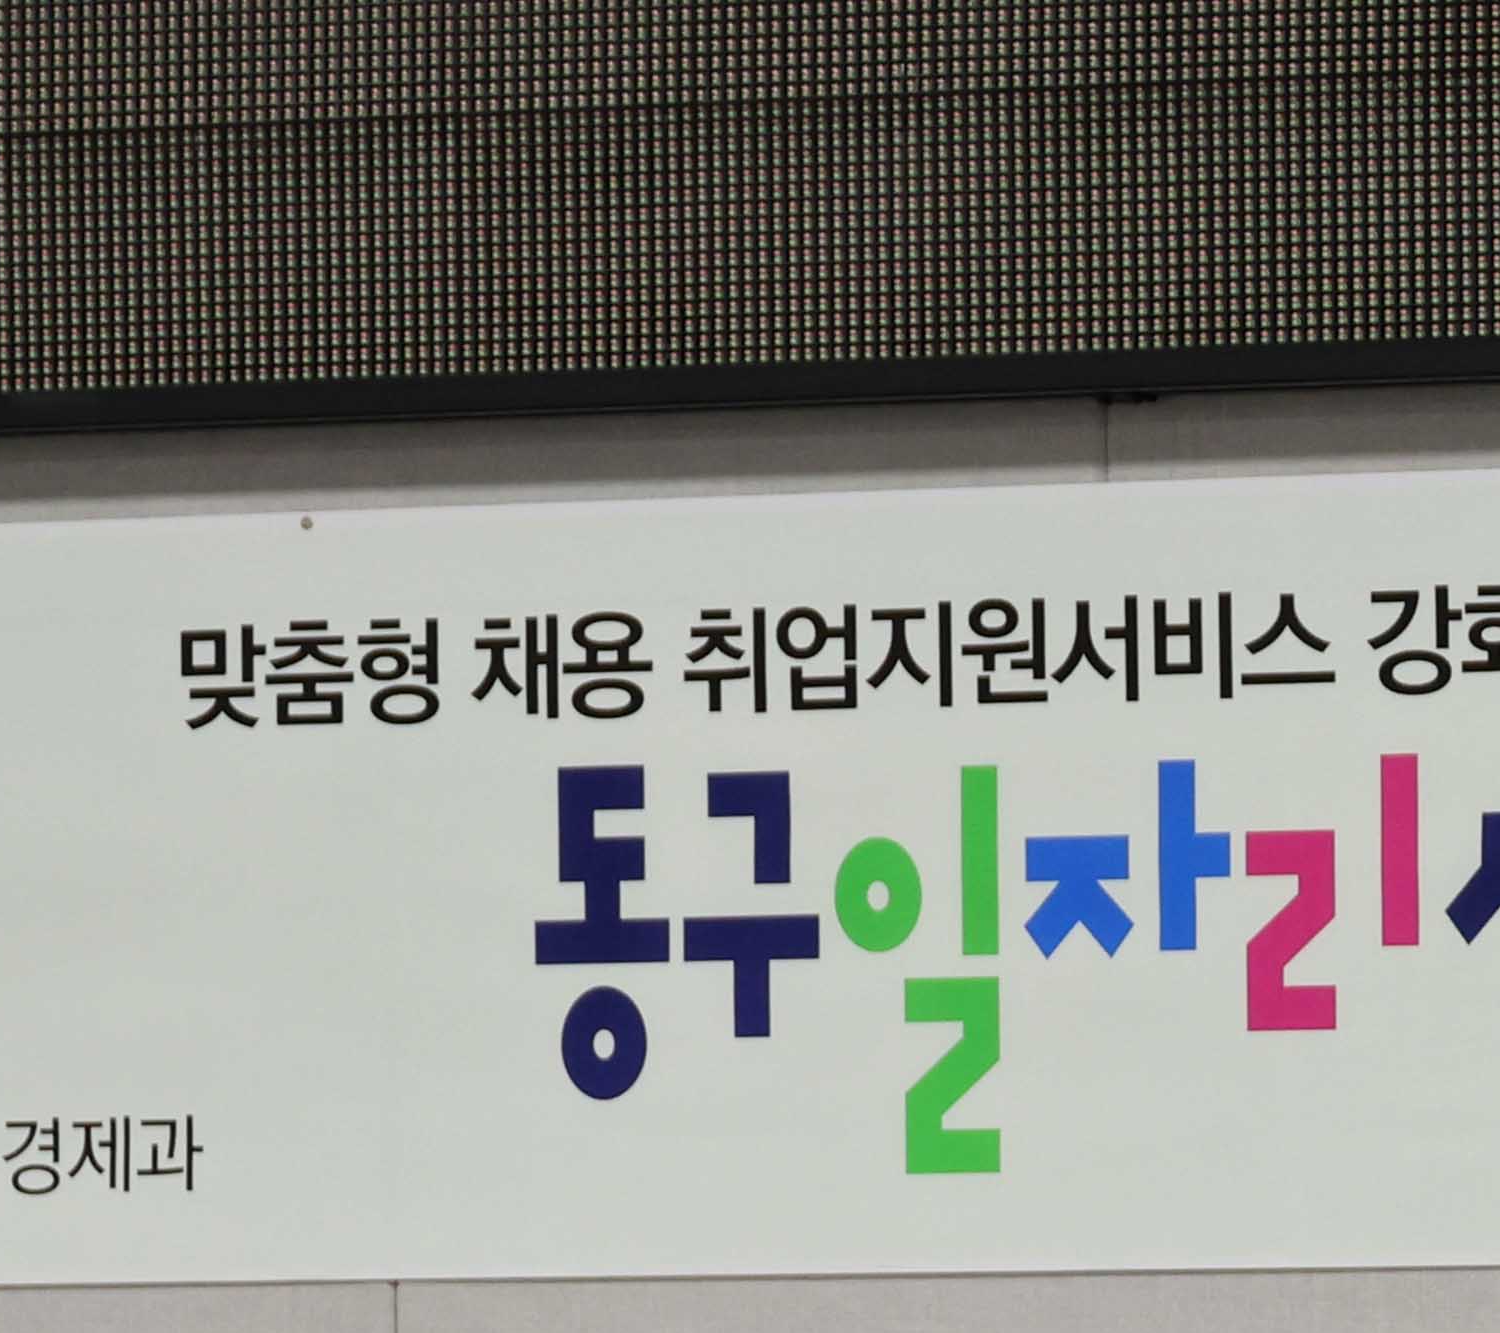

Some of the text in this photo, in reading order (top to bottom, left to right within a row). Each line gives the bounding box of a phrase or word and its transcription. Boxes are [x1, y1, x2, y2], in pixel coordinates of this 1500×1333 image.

[180, 618, 441, 731] 맞춤형
[471, 611, 655, 720] 채용
[683, 591, 1338, 714] 취업지원서비스
